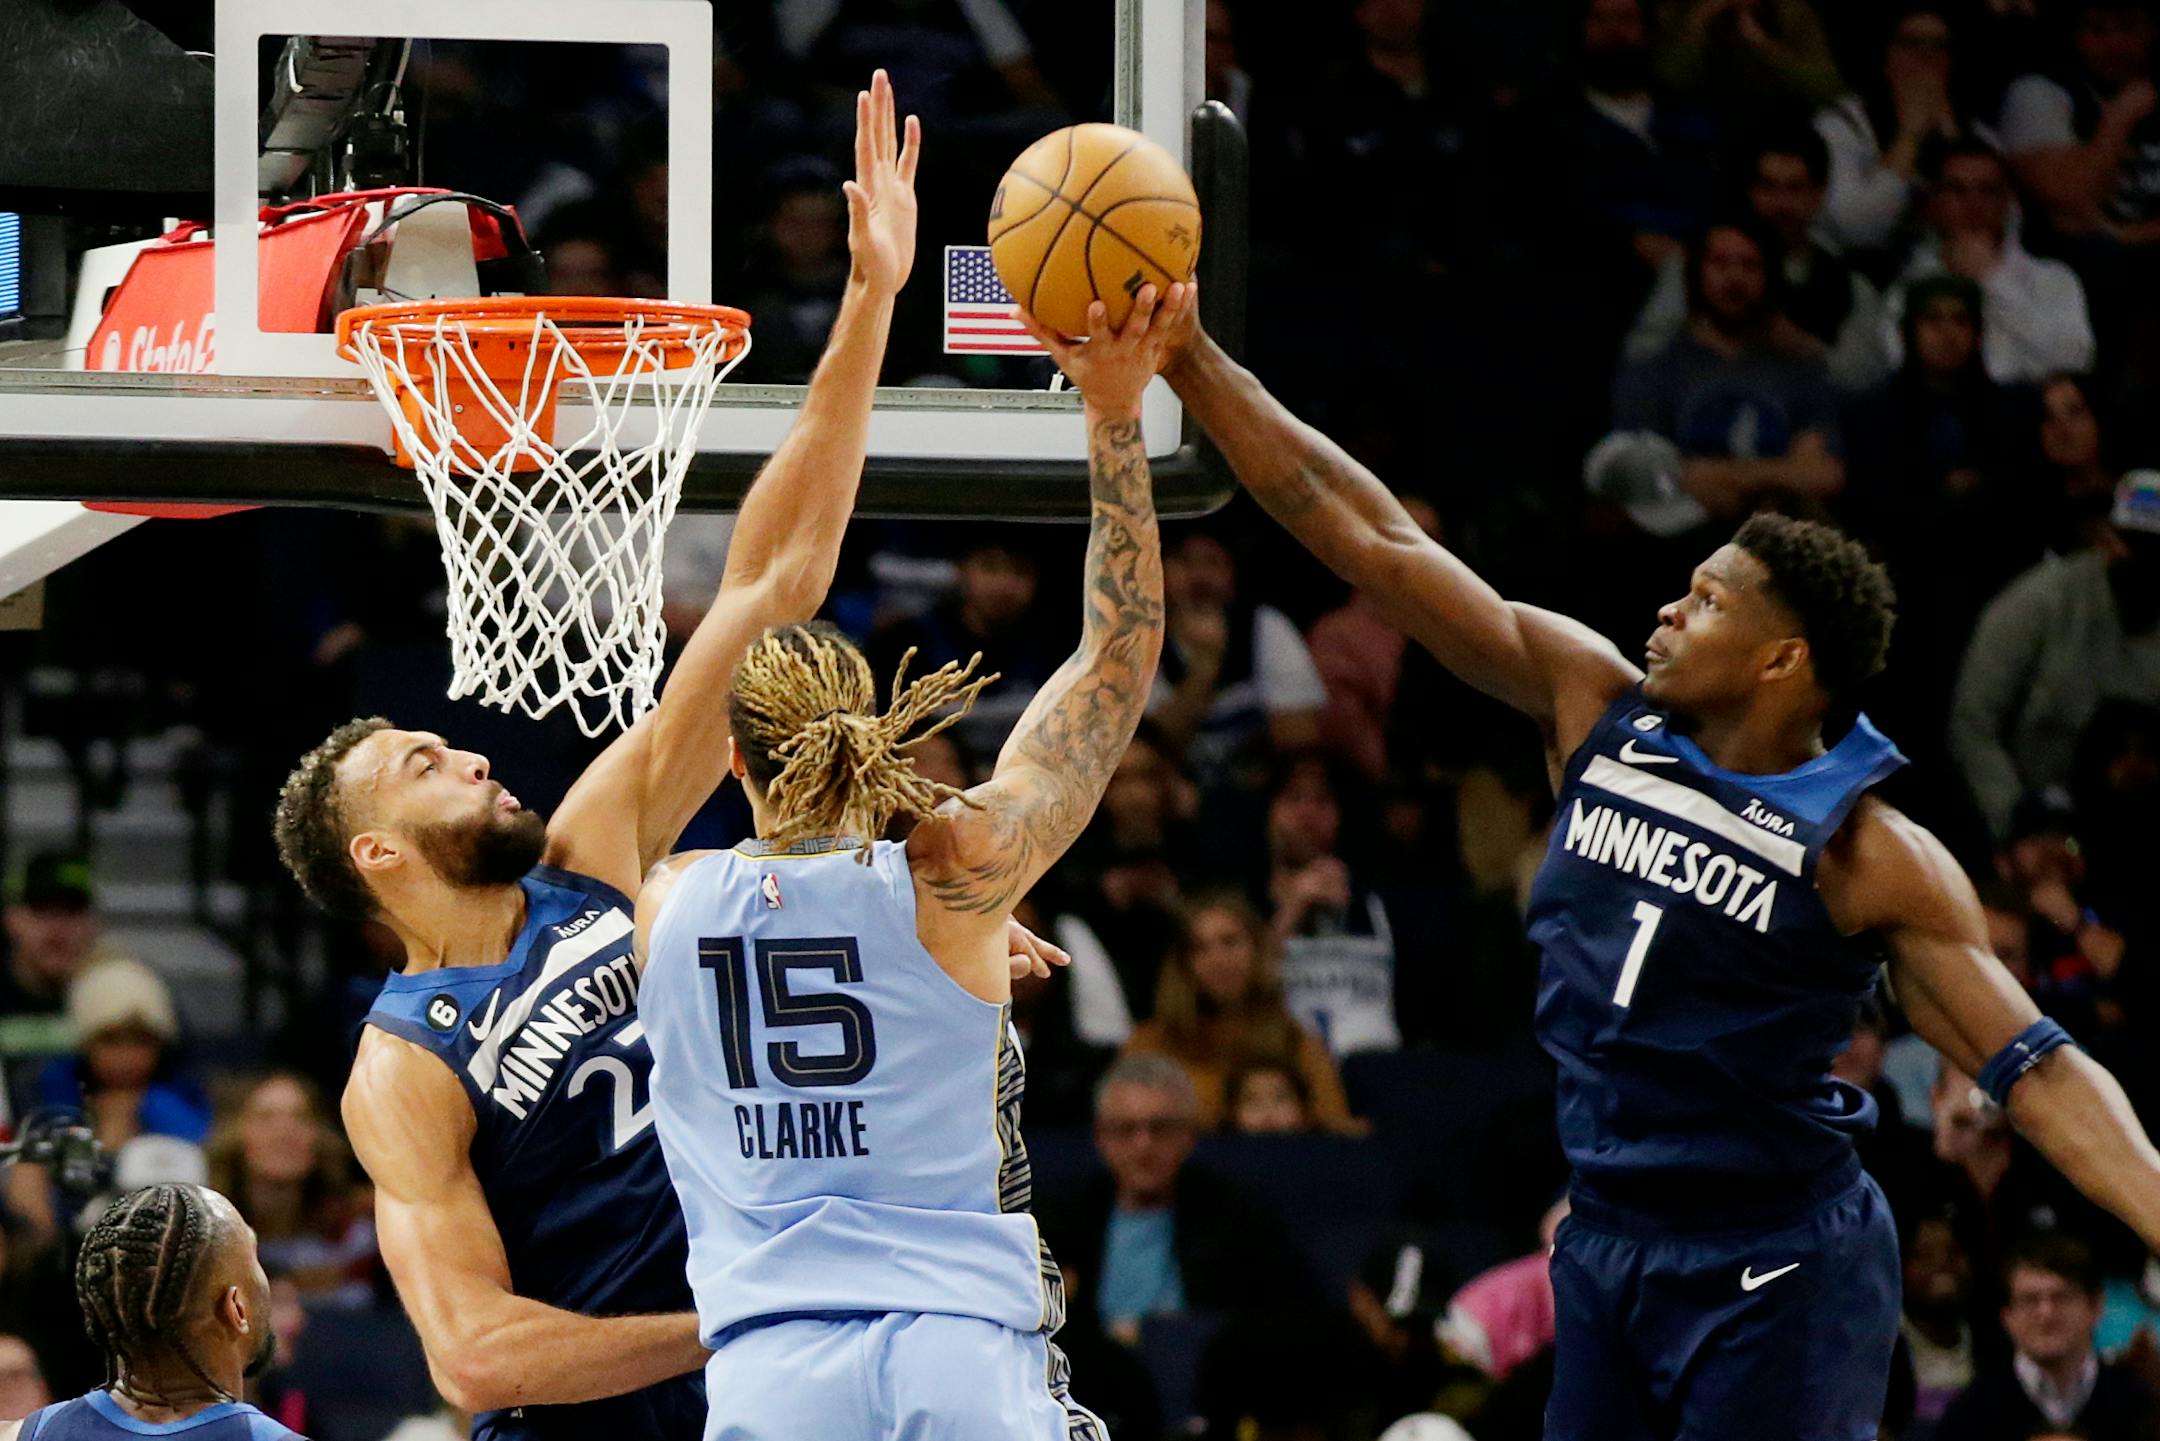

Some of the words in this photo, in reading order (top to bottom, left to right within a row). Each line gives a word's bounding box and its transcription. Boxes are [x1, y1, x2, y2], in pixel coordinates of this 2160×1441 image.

[1564, 798, 1778, 933] MINNESOTA
[429, 999, 458, 1028] 6
[698, 936, 877, 1089] 15
[1612, 900, 1664, 1008] 1
[493, 952, 640, 1121] MINNESOT
[733, 1101, 869, 1159] CLARKE
